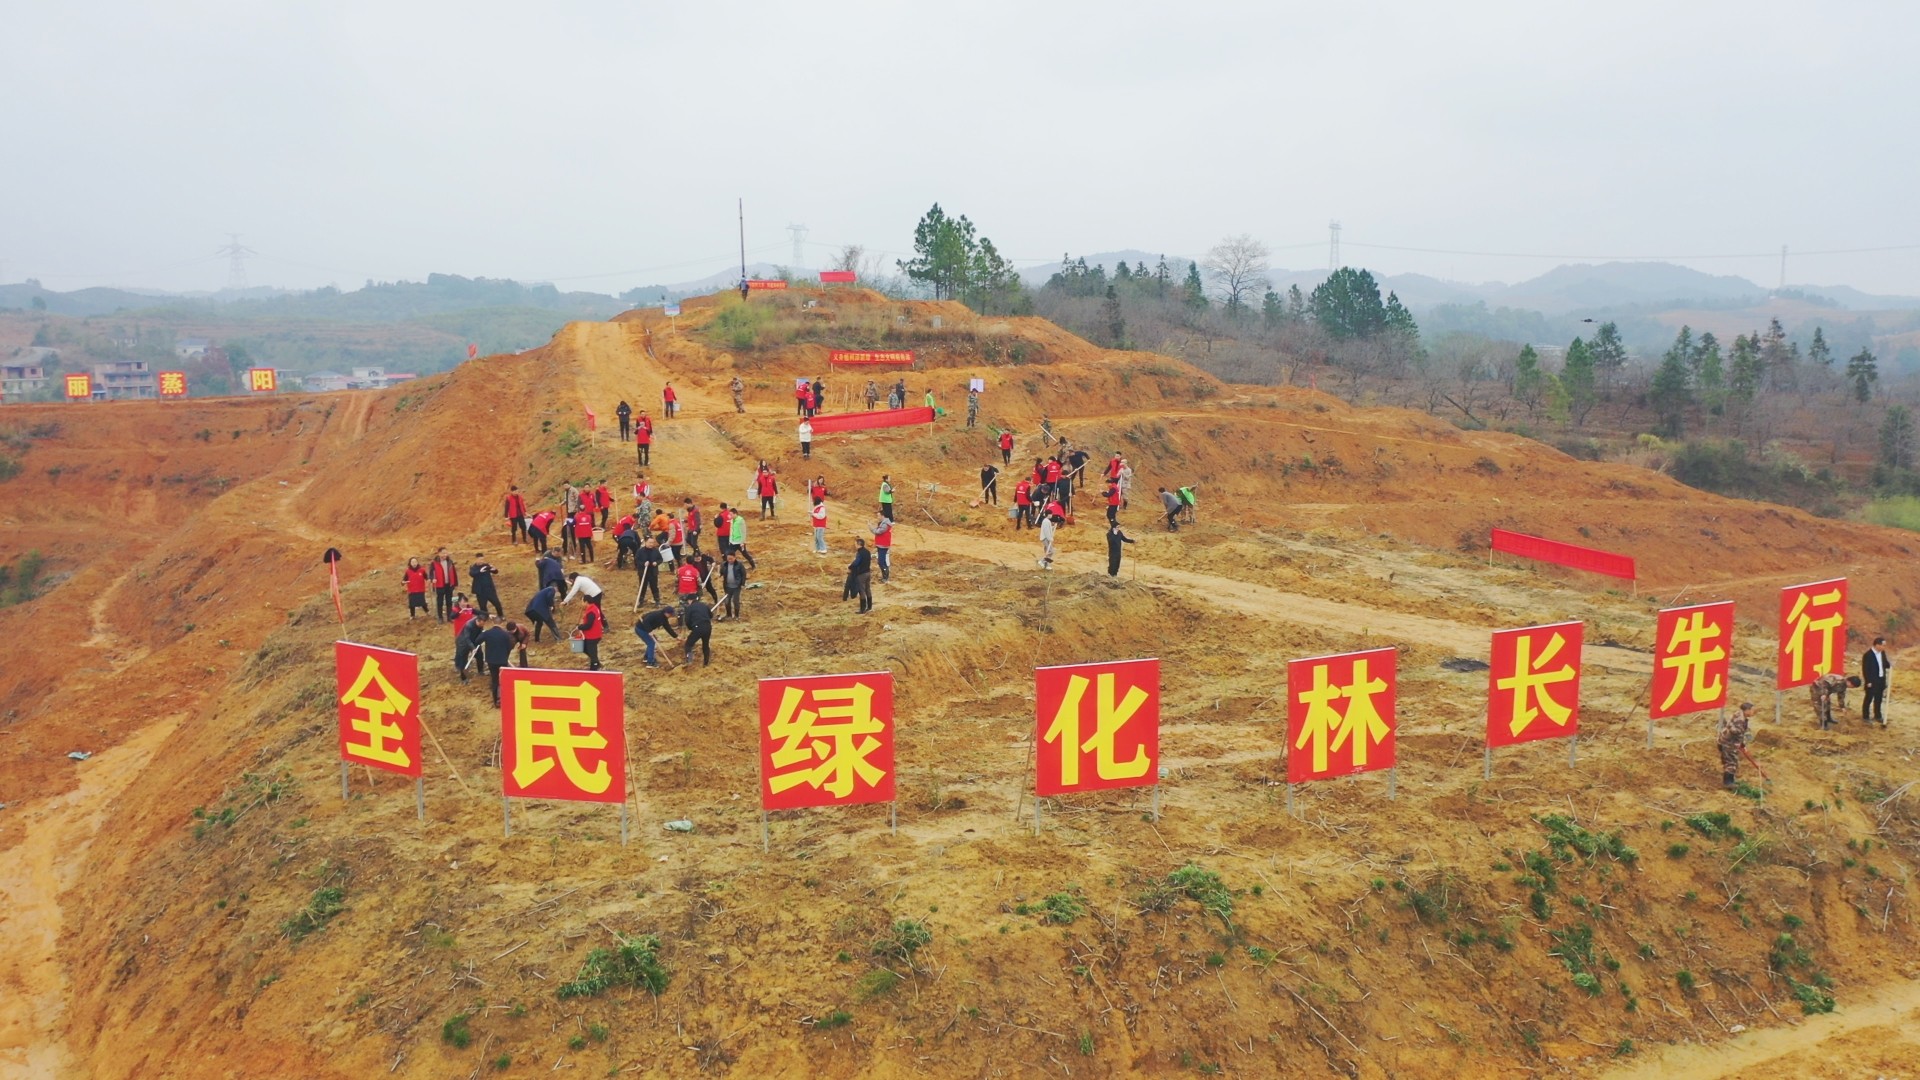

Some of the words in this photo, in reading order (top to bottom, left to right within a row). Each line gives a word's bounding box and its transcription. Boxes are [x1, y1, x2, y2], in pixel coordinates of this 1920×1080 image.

[66, 376, 89, 396] 丽
[162, 373, 184, 394] 蒸
[252, 370, 273, 391] 阳
[1497, 633, 1576, 737] 长
[1660, 611, 1726, 712] 先
[1785, 588, 1844, 682] 行
[340, 655, 412, 768] 全
[512, 679, 612, 794] 民
[768, 682, 886, 798] 绿
[1044, 673, 1151, 786] 化
[1296, 659, 1391, 772] 林
